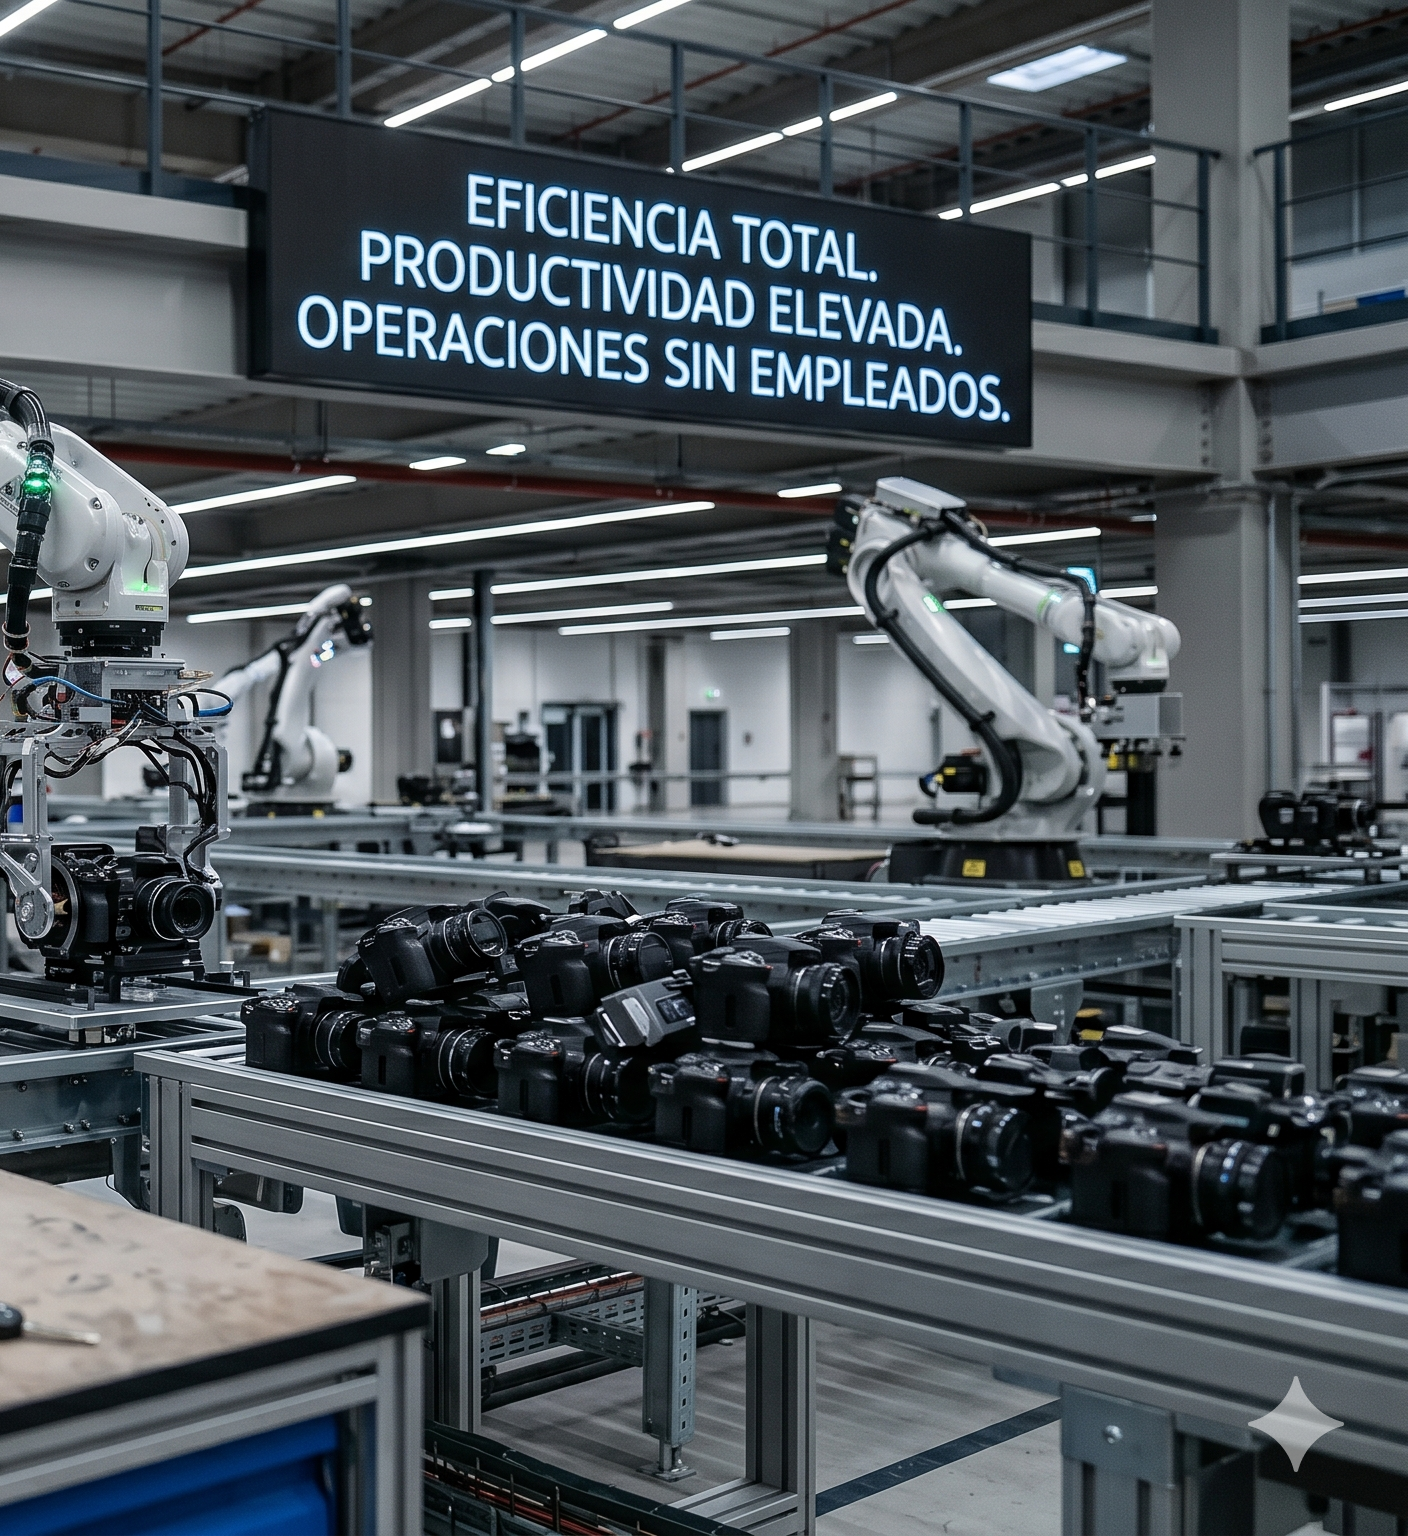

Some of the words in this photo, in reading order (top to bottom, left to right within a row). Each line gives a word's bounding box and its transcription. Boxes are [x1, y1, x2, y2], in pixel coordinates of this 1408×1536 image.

[467, 173, 722, 260] EFICIENCIA
[731, 214, 878, 283] TOTAL.
[360, 229, 755, 329] PRODUCTIVIDAD
[769, 285, 963, 357] ELEVADA.
[297, 294, 650, 384] OPERACIONES
[664, 338, 736, 393] SIN
[750, 347, 1011, 423] EMPLEADOS.
